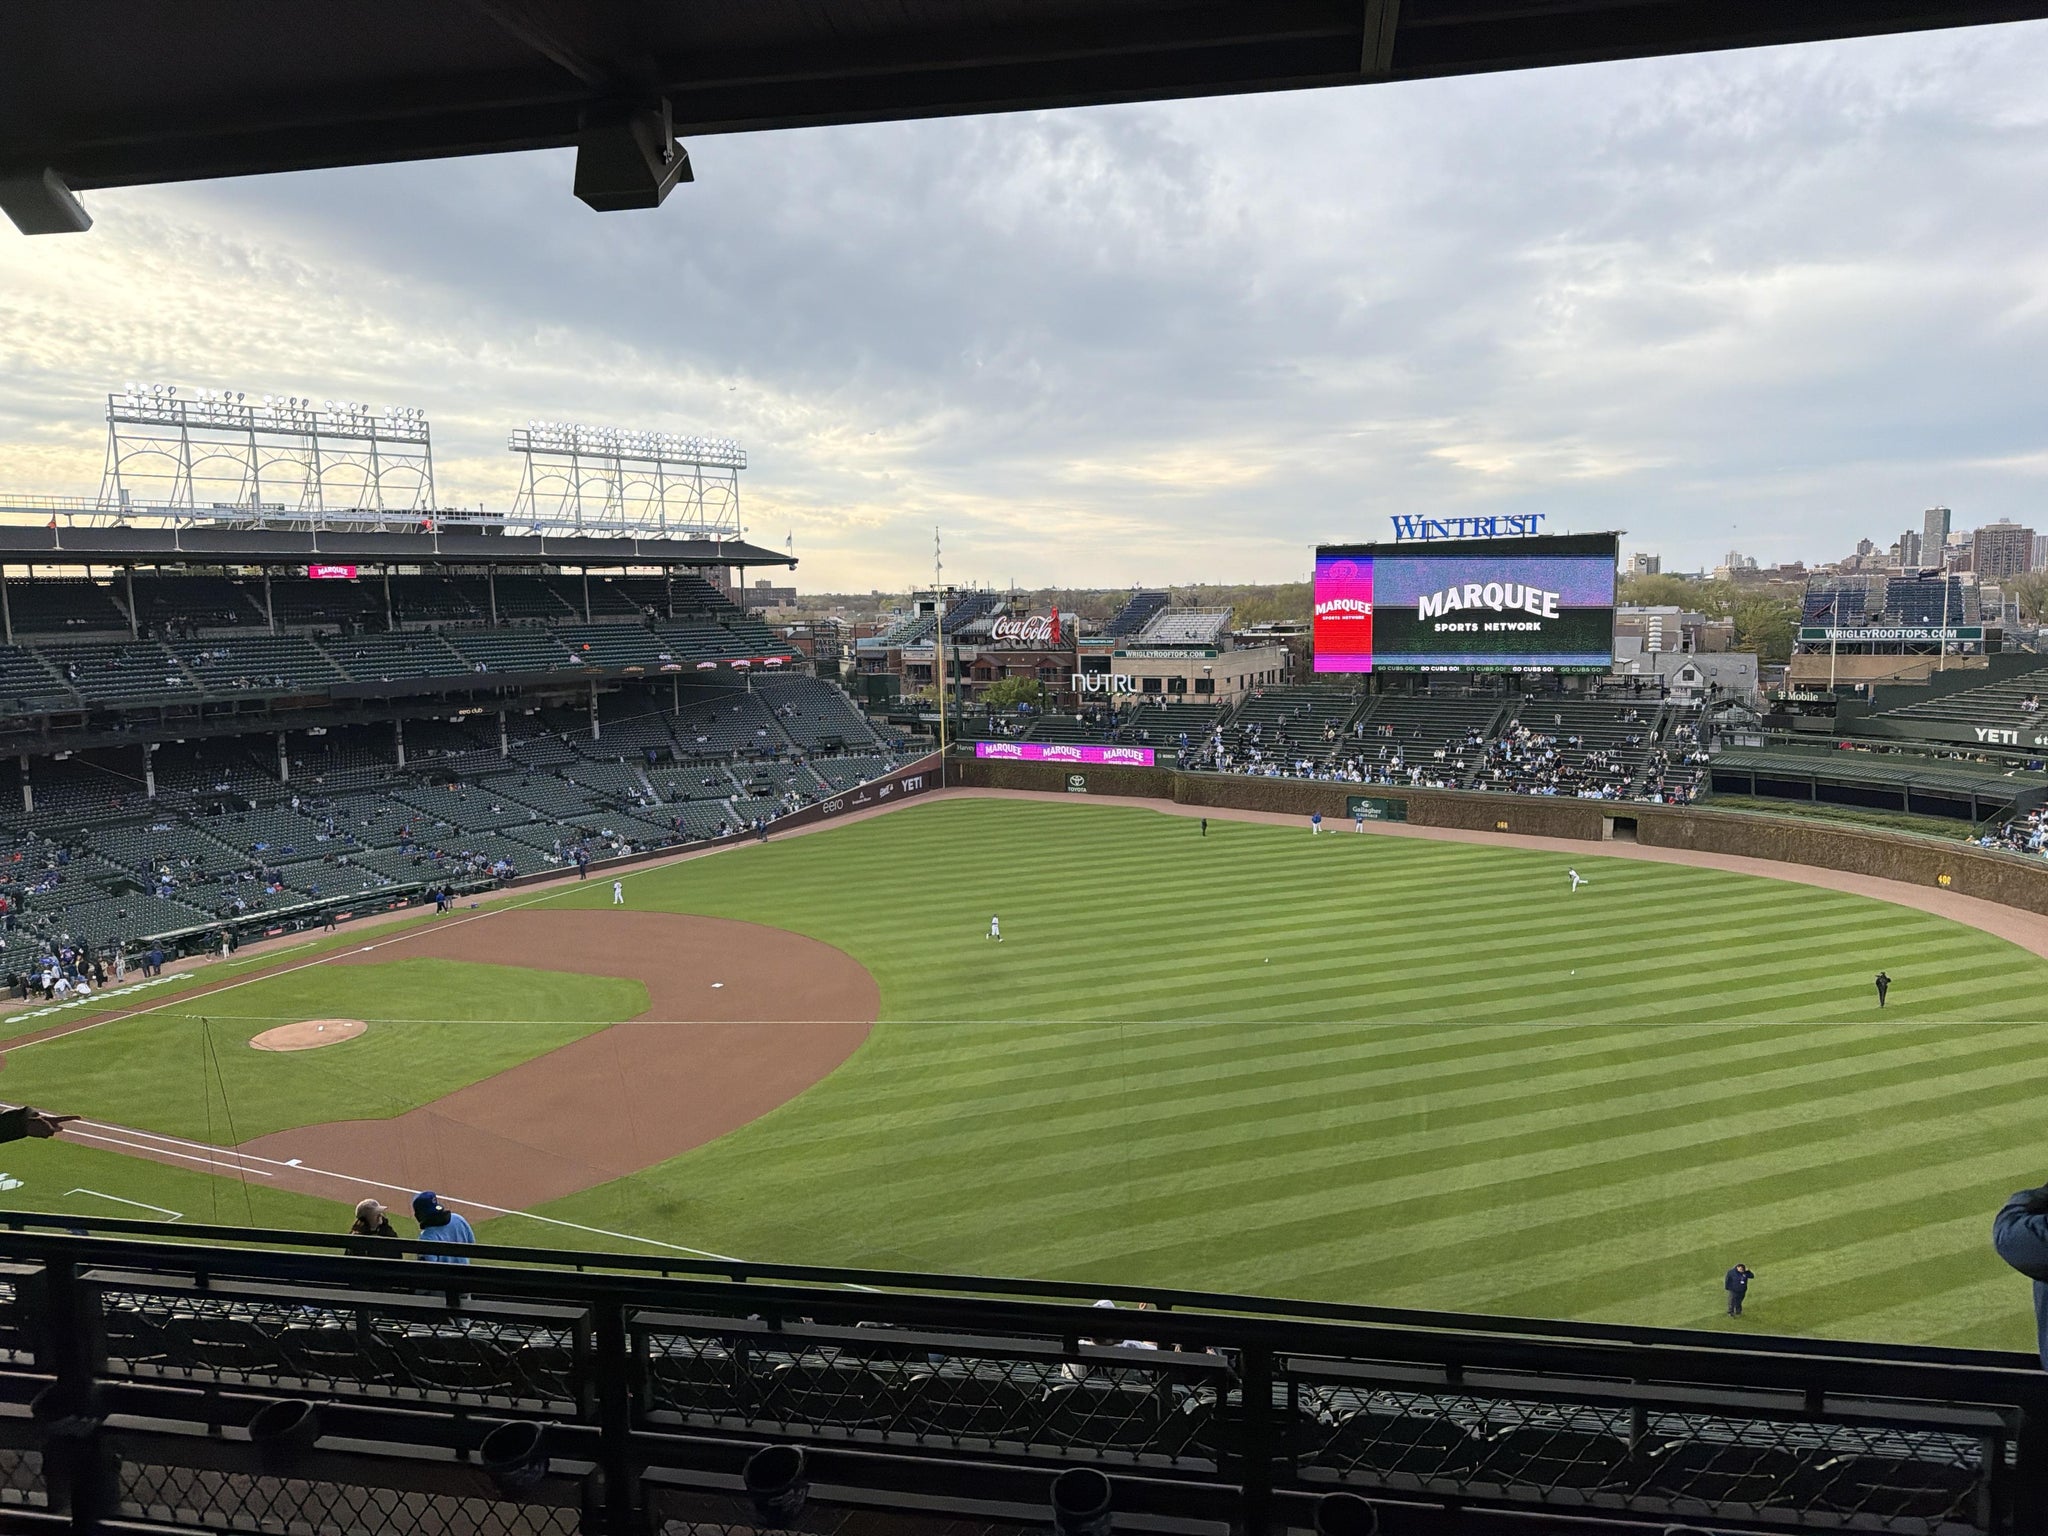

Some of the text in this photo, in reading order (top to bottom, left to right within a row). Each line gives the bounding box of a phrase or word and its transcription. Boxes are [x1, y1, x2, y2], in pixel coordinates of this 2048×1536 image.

[1390, 513, 1546, 540] WINTRUST
[1315, 599, 1372, 616] MARQUEE
[1418, 582, 1560, 621] MARQUEE
[991, 616, 1056, 640] Coca-Cola
[1434, 622, 1542, 632] SPORTS NETWORK
[1825, 629, 1957, 639] WRIGLEYROOFTOPS.COM
[1788, 692, 1819, 701] Mobile
[1975, 727, 2019, 745] YETI
[985, 743, 1022, 756] MARQUEE
[1043, 745, 1082, 759] MARQUEE
[1103, 748, 1144, 762] MARQUEE
[901, 776, 923, 792] YETI
[822, 799, 844, 813] eero
